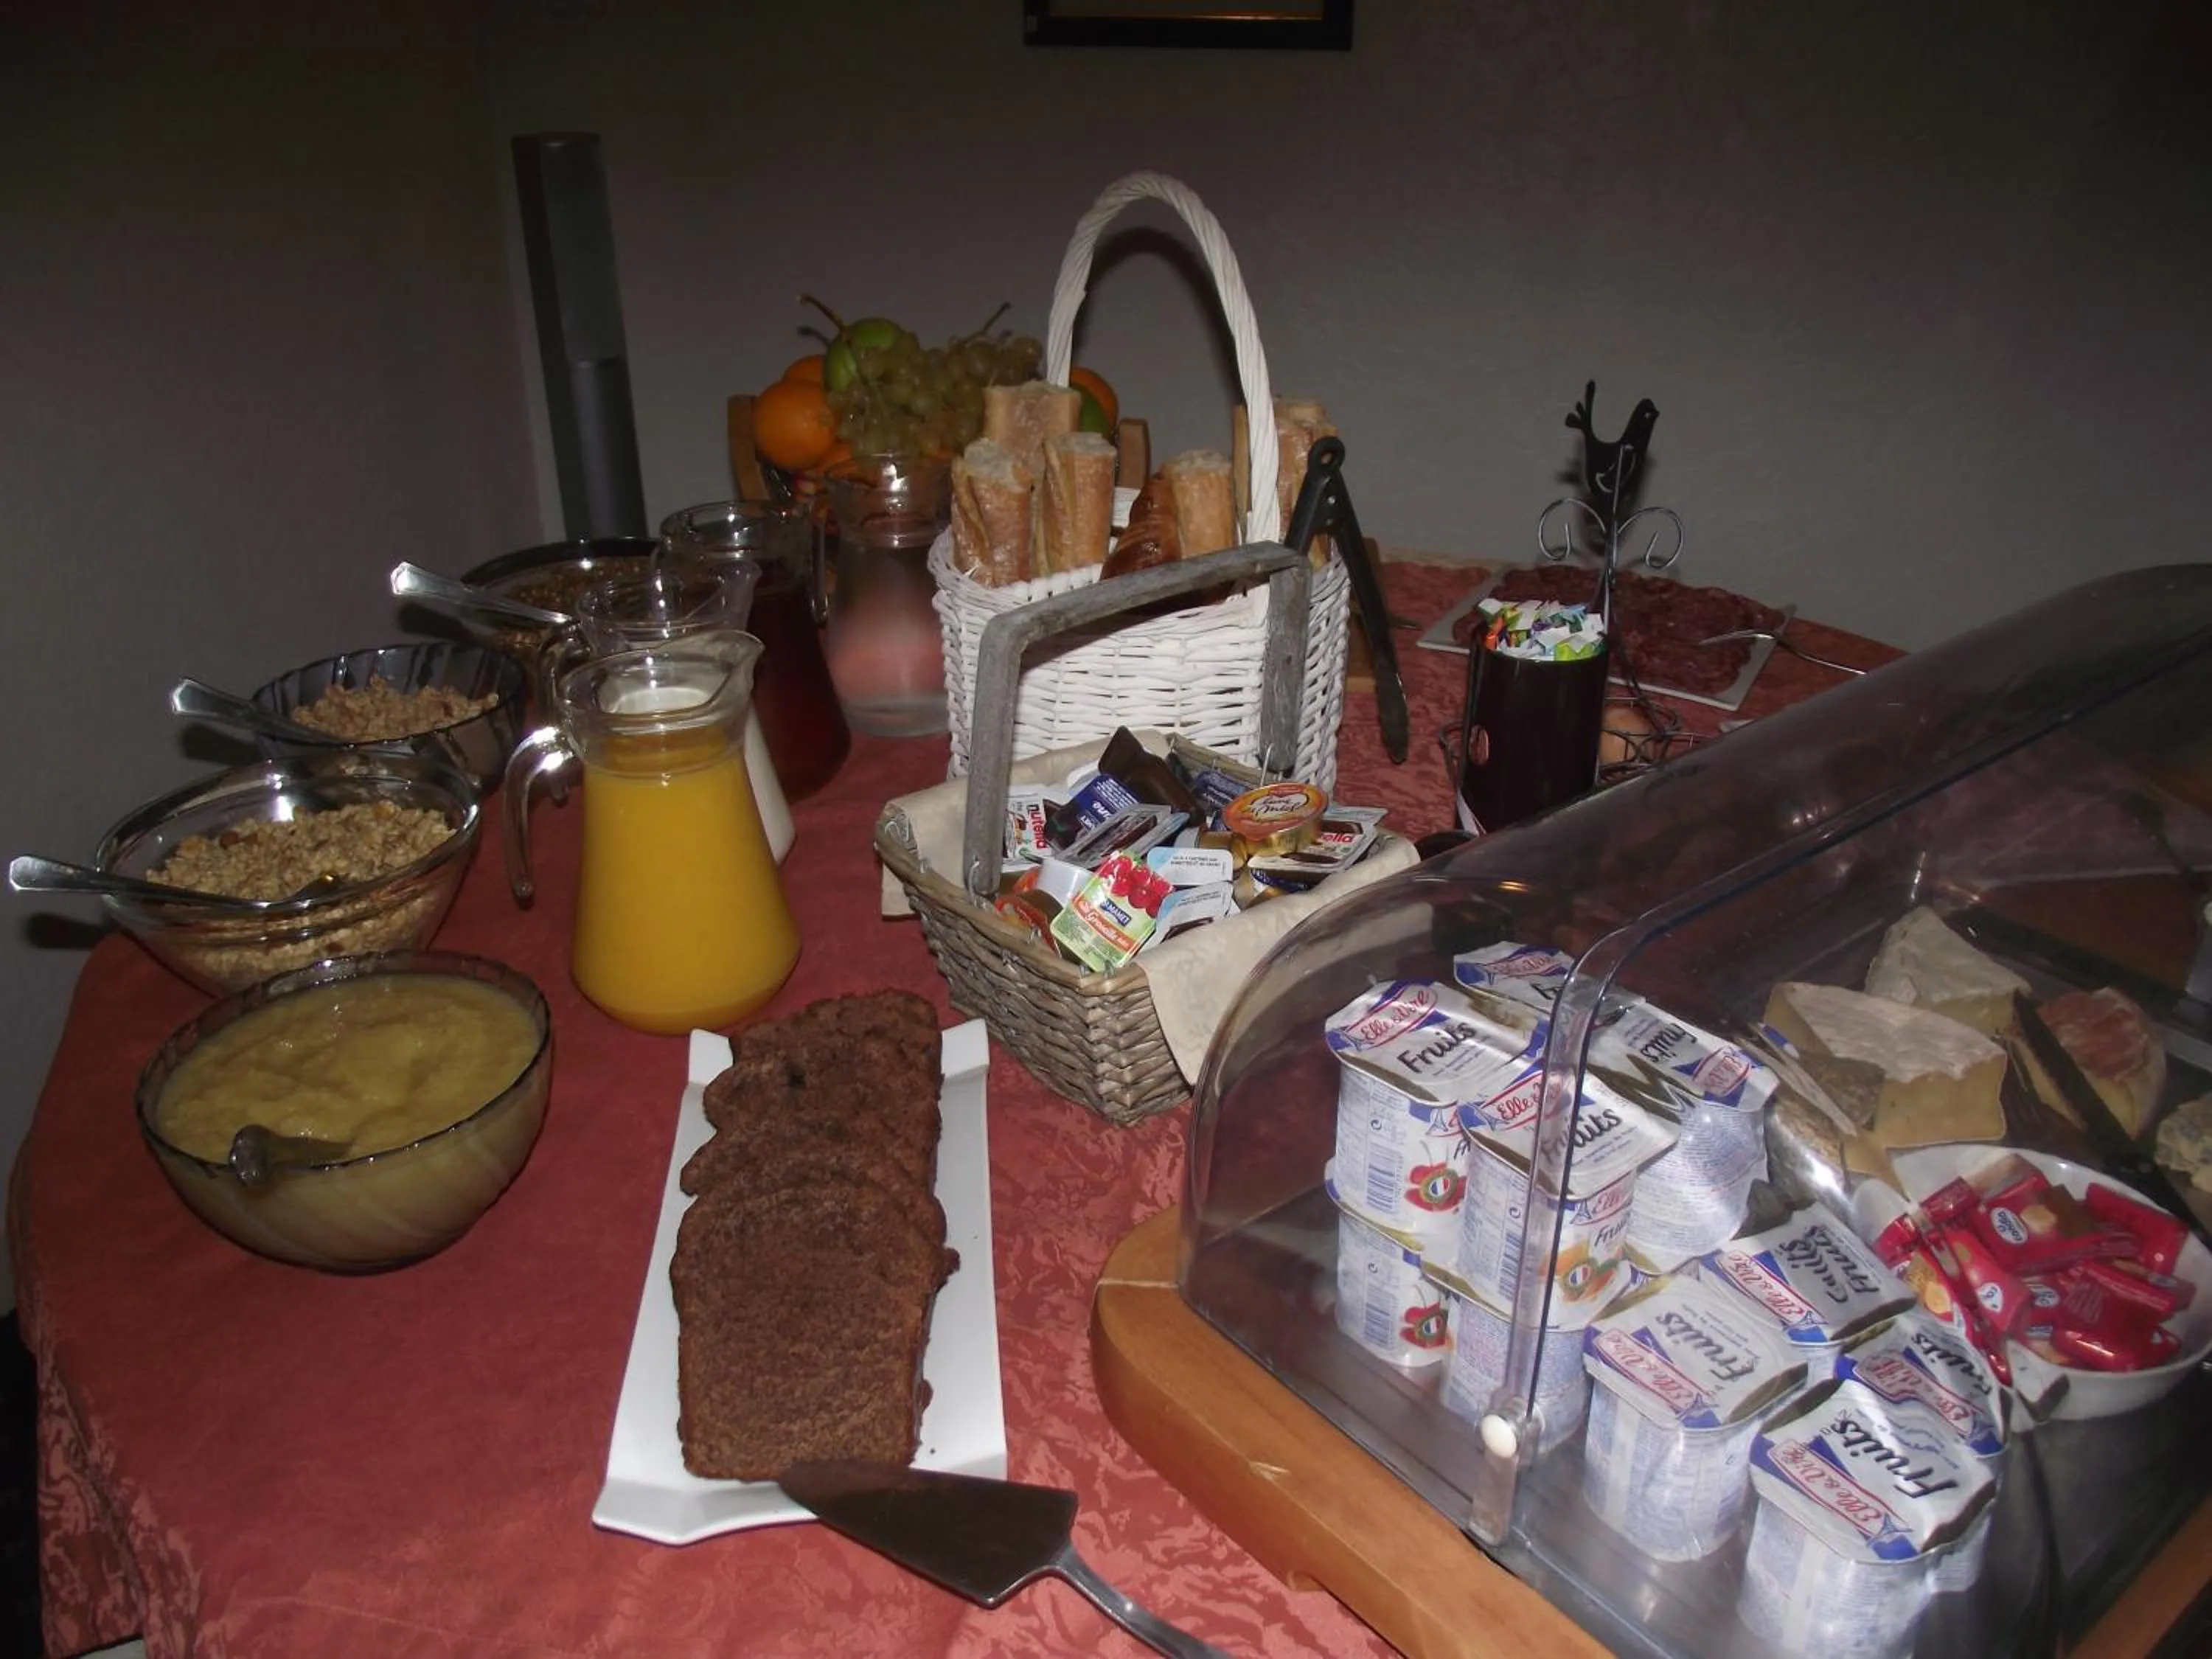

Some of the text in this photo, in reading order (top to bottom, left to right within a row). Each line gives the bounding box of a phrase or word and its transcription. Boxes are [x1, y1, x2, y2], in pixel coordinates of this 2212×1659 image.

[1322, 832, 1353, 843] ella
[1361, 1019, 1390, 1040] Elle
[1397, 1022, 1475, 1074] Fruits
[1640, 1023, 1698, 1062] Fruits
[1497, 1098, 1529, 1121] Elle
[1655, 1311, 1756, 1381] Fruits
[1831, 1419, 1959, 1498] Fruits
[1836, 1487, 1882, 1523] Elle
